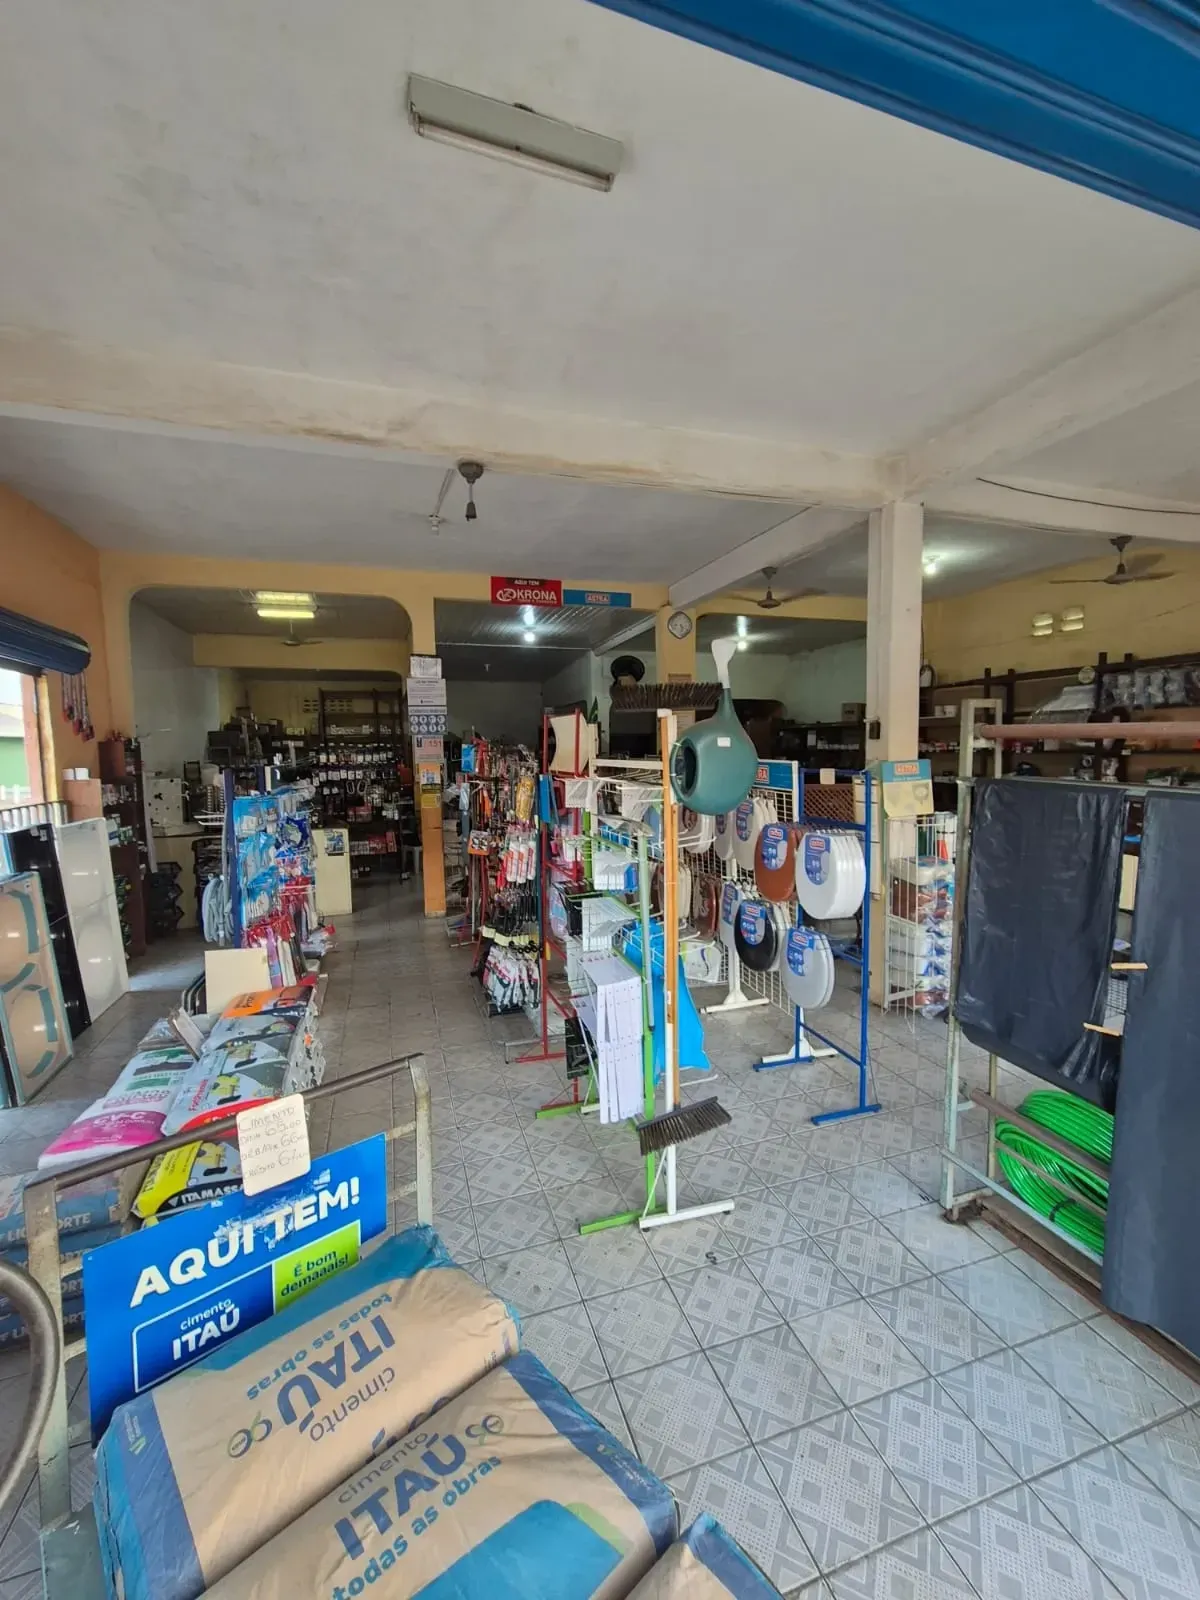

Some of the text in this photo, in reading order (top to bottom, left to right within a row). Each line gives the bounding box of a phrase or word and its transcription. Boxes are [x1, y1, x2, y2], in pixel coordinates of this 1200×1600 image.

[517, 589, 557, 601] KRONA
[239, 1108, 295, 1132] CIMENTO
[130, 1176, 361, 1308] AQUI TEM!
[280, 1254, 350, 1297] demaaais!
[293, 1250, 338, 1277] É bom
[172, 1303, 241, 1361] ITAÚ
[180, 1298, 233, 1331] cimento
[246, 1292, 392, 1401] todas as obras
[277, 1315, 396, 1434] ITAÚ
[310, 1366, 396, 1442] cimento
[334, 1432, 467, 1561] ITAÚ
[338, 1432, 429, 1504] cimento
[332, 1455, 502, 1600] todas as obras
